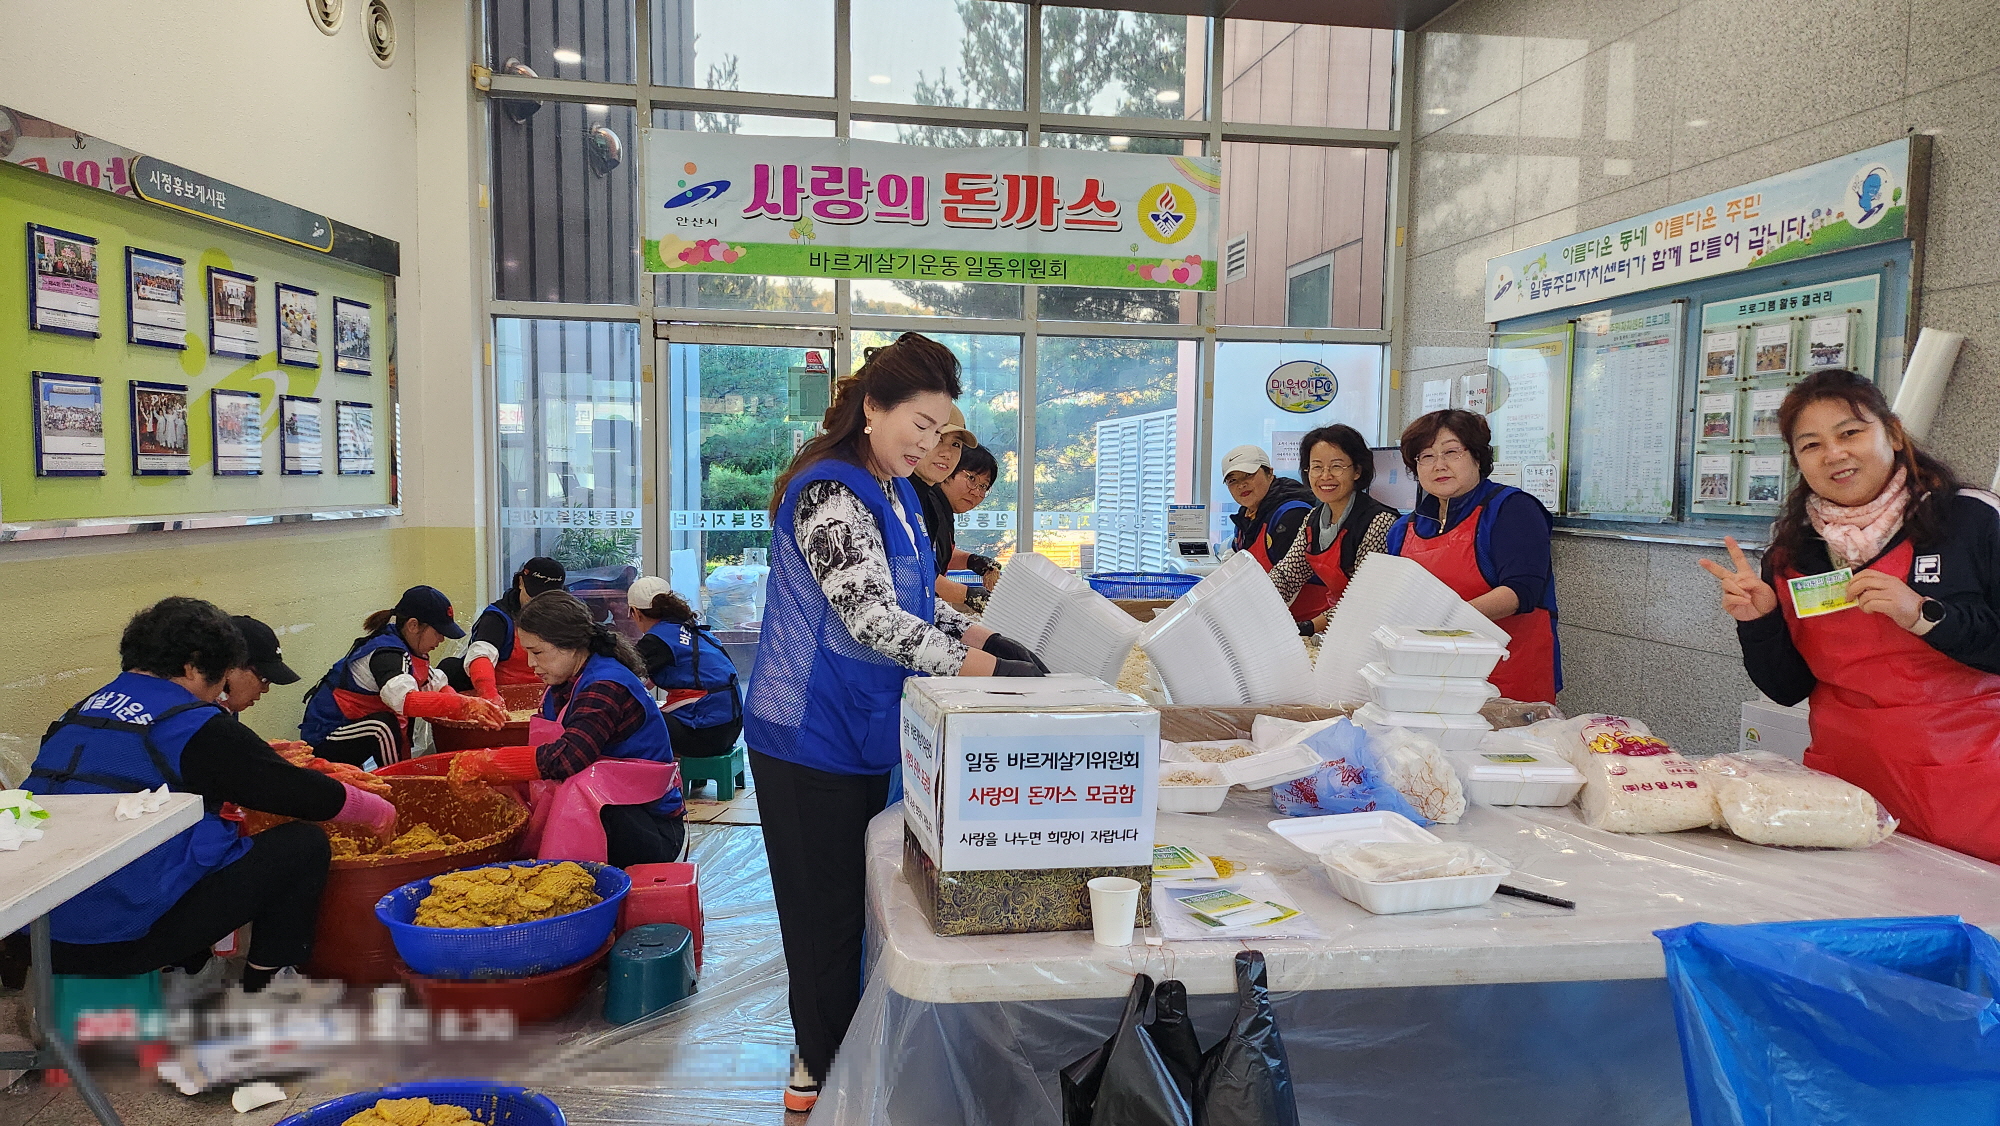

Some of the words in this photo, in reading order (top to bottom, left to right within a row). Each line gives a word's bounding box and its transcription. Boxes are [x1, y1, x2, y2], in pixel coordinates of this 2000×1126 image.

[149, 170, 227, 210] 시정홍보게시판
[743, 163, 928, 225] 사랑의
[940, 172, 1122, 232] 돈까스
[676, 216, 718, 228] 안산시
[1562, 235, 1613, 266] 아름다운
[1619, 225, 1648, 252] 동네
[1654, 205, 1718, 241] 아름다운
[1725, 193, 1762, 221] 주민
[809, 251, 961, 276] 바르게살기운동
[965, 252, 1069, 280] 일동위원회
[1529, 254, 1647, 301] 일동주민자치센터가
[1651, 244, 1682, 273] 함께
[1688, 230, 1741, 264] 만들어
[1747, 214, 1812, 252] 갑니다.
[1737, 299, 1777, 316] 프로그램
[1779, 297, 1798, 311] 활동
[1801, 290, 1833, 307] 갤러리
[1914, 575, 1941, 583] FILA
[965, 752, 1000, 773] 일동
[1007, 750, 1140, 771] 바르게살기위원회
[967, 786, 1019, 807] 사랑의
[1027, 785, 1078, 806] 돈까스
[1085, 783, 1137, 805] 모금함
[959, 831, 999, 847] 사랑을
[1004, 830, 1042, 846] 나누면
[1047, 830, 1085, 846] 희망이
[1090, 828, 1139, 844] 자랍니다
